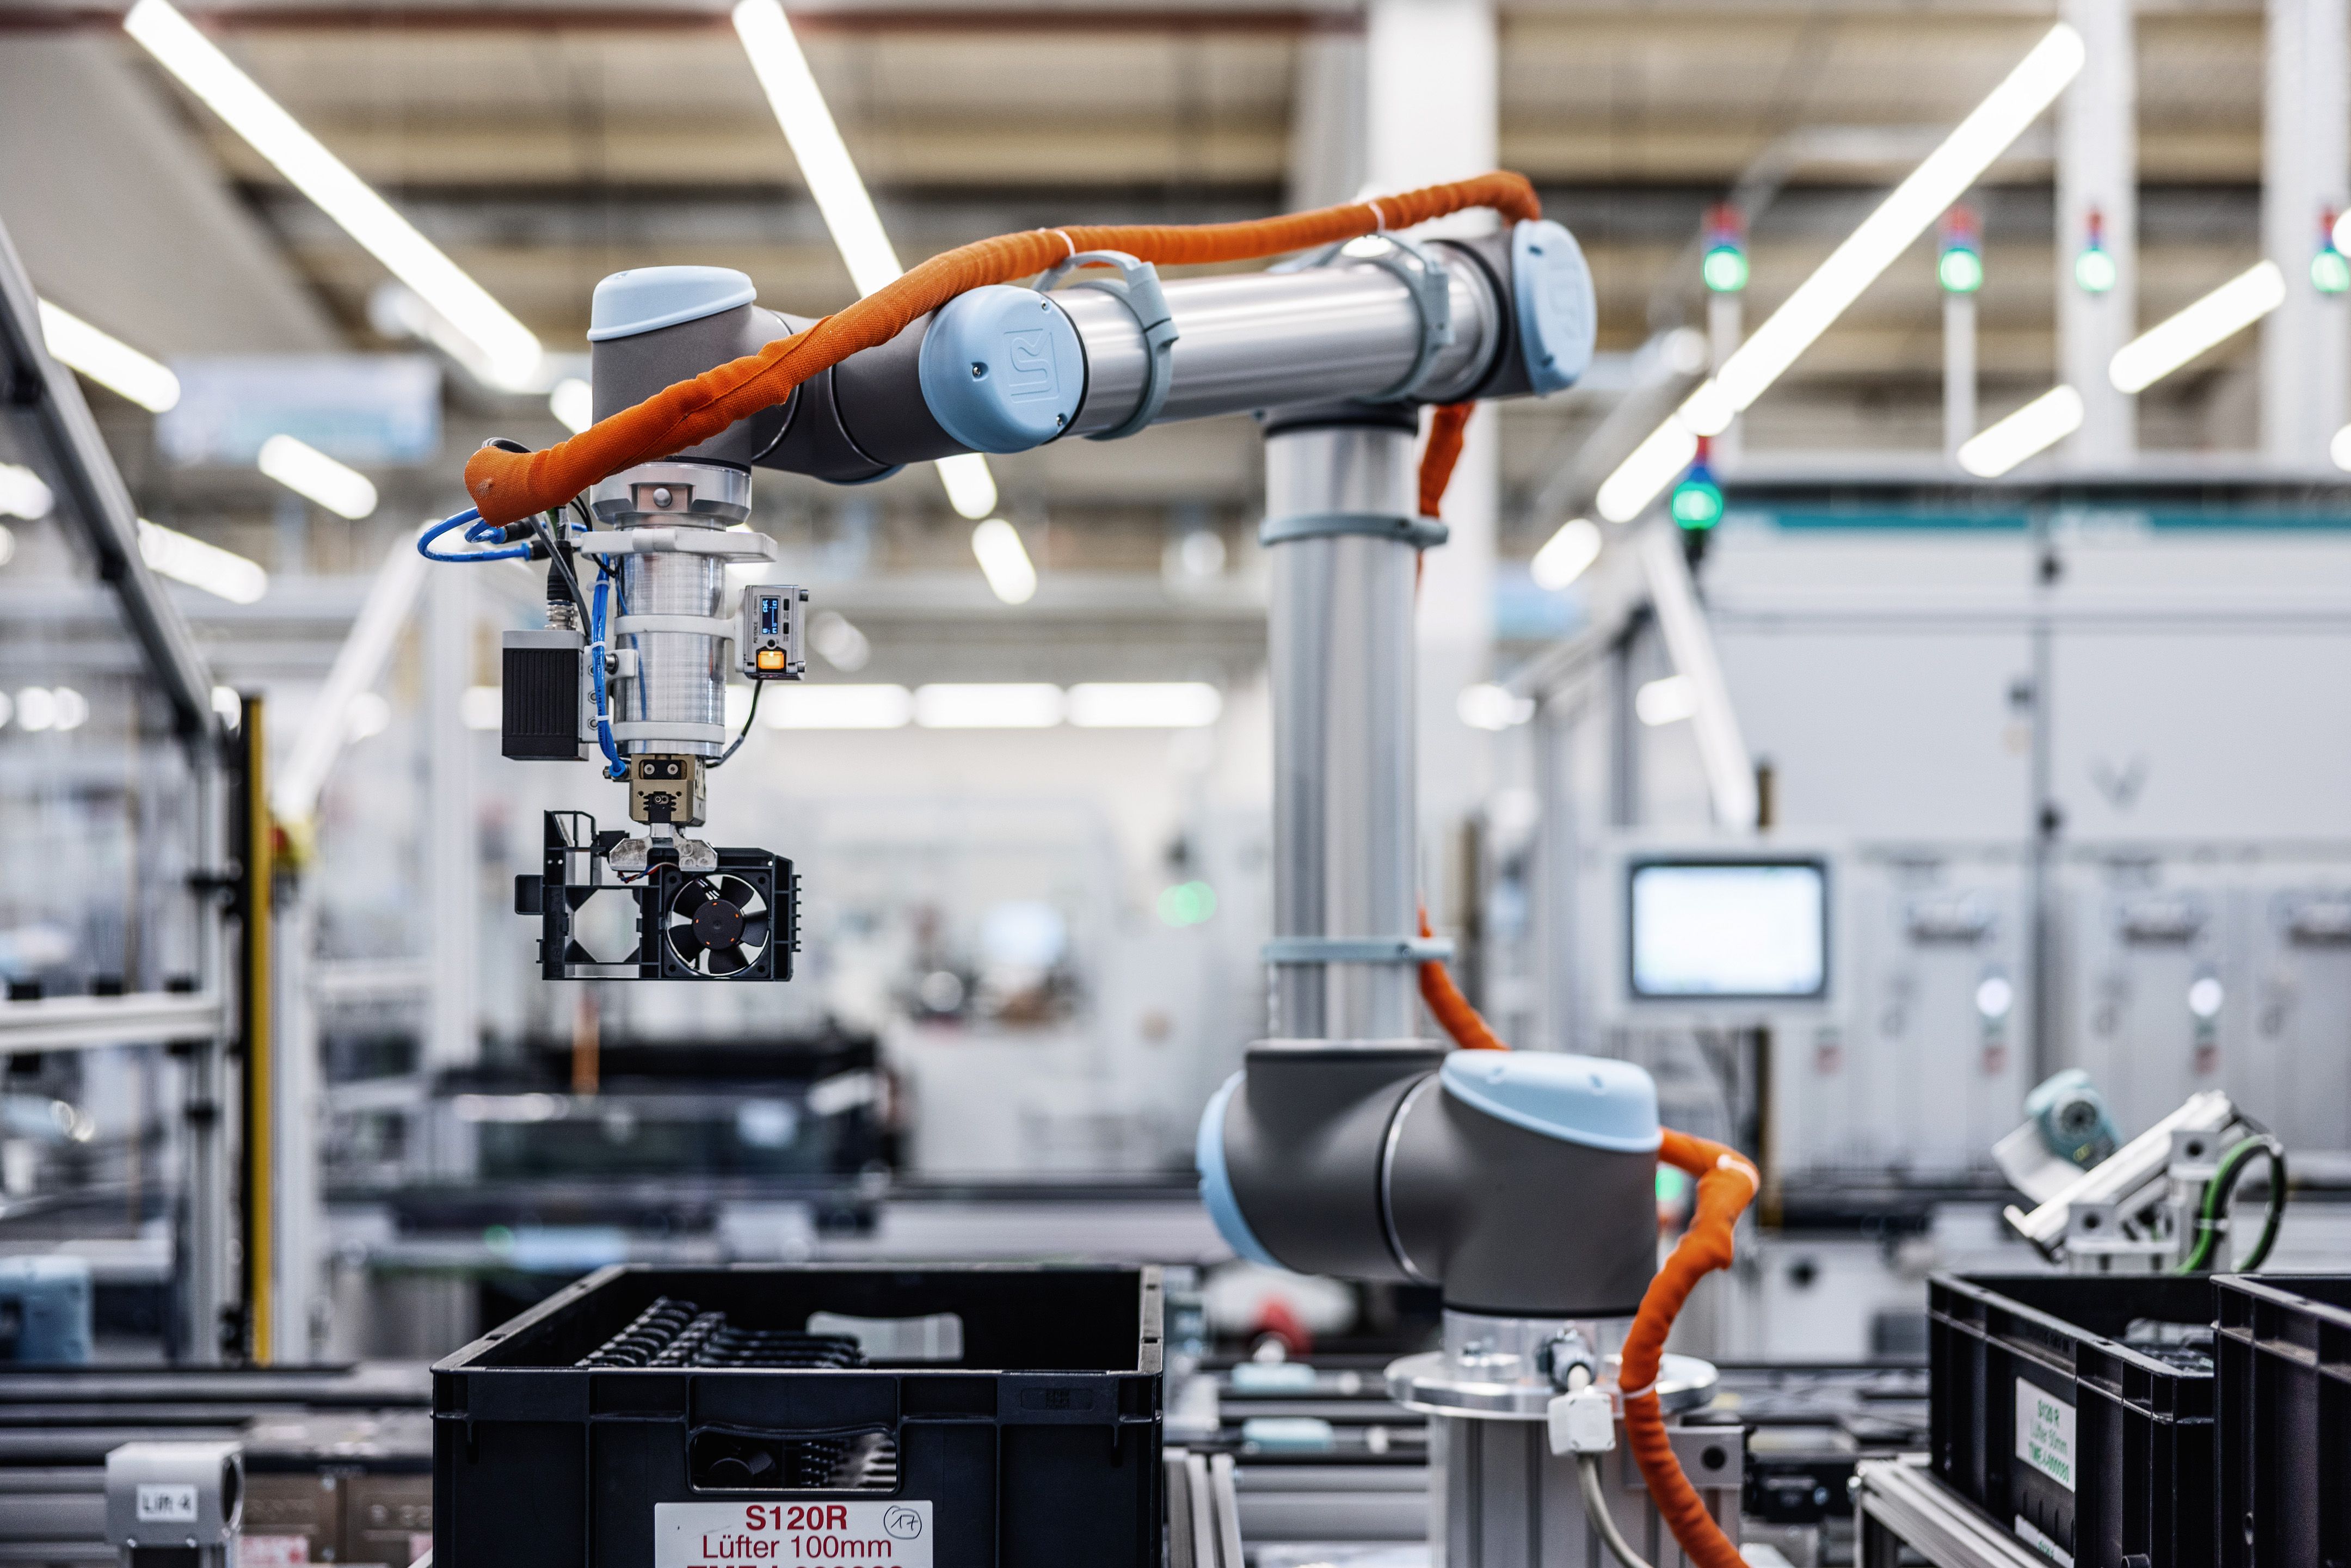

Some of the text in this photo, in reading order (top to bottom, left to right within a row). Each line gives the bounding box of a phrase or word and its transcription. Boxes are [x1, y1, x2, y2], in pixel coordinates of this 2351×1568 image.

[141, 1493, 173, 1512] Lift
[746, 1505, 847, 1530] S120R
[703, 1534, 892, 1559] Lüfter 100mm
